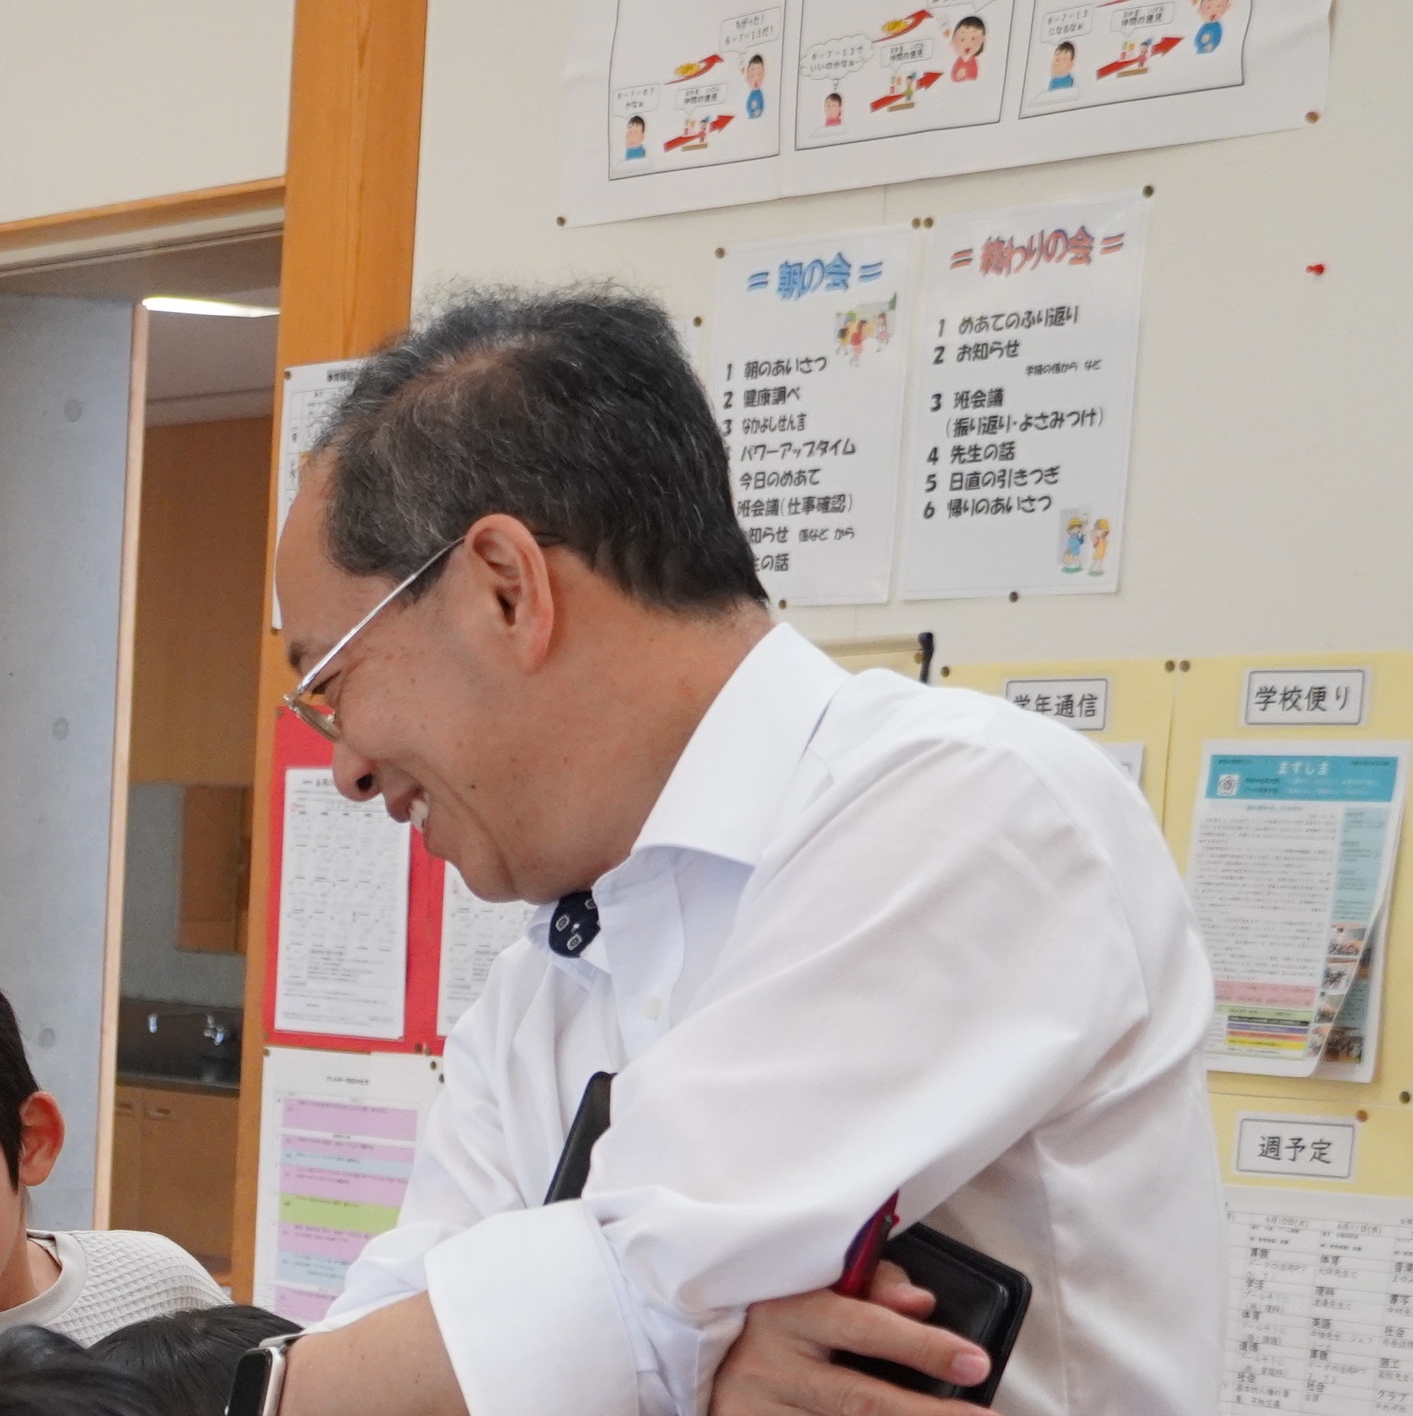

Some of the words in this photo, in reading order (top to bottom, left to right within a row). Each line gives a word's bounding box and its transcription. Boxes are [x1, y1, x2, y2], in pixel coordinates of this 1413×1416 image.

[979, 225, 1094, 276] 終わりの会
[776, 252, 851, 299] 朝の会
[938, 319, 945, 337] 1
[958, 305, 1079, 335] めあてのふり返り
[934, 347, 945, 365] 2
[957, 340, 1020, 362] お知らせ
[726, 362, 733, 381] 1
[744, 357, 827, 379] 朝のあいさつ
[723, 392, 734, 409] 2
[743, 387, 801, 408] 健康調べ
[931, 394, 942, 411] 3
[954, 388, 1004, 410] 班会議
[723, 419, 733, 436] 3
[741, 439, 856, 462] パワーアップタイム
[927, 447, 938, 465] 4
[950, 442, 1016, 464] 先生の話
[739, 468, 821, 491] 今日のめあて
[925, 475, 937, 492] 5
[949, 466, 1060, 491] 日直の引きつぎ
[924, 501, 934, 520] 6
[947, 496, 1052, 519] 帰りのあいさつ
[744, 526, 788, 545] 知らせ
[1012, 692, 1098, 719] 学年通信
[1254, 685, 1351, 713] 学校便り
[1258, 1136, 1332, 1164] 週予定
